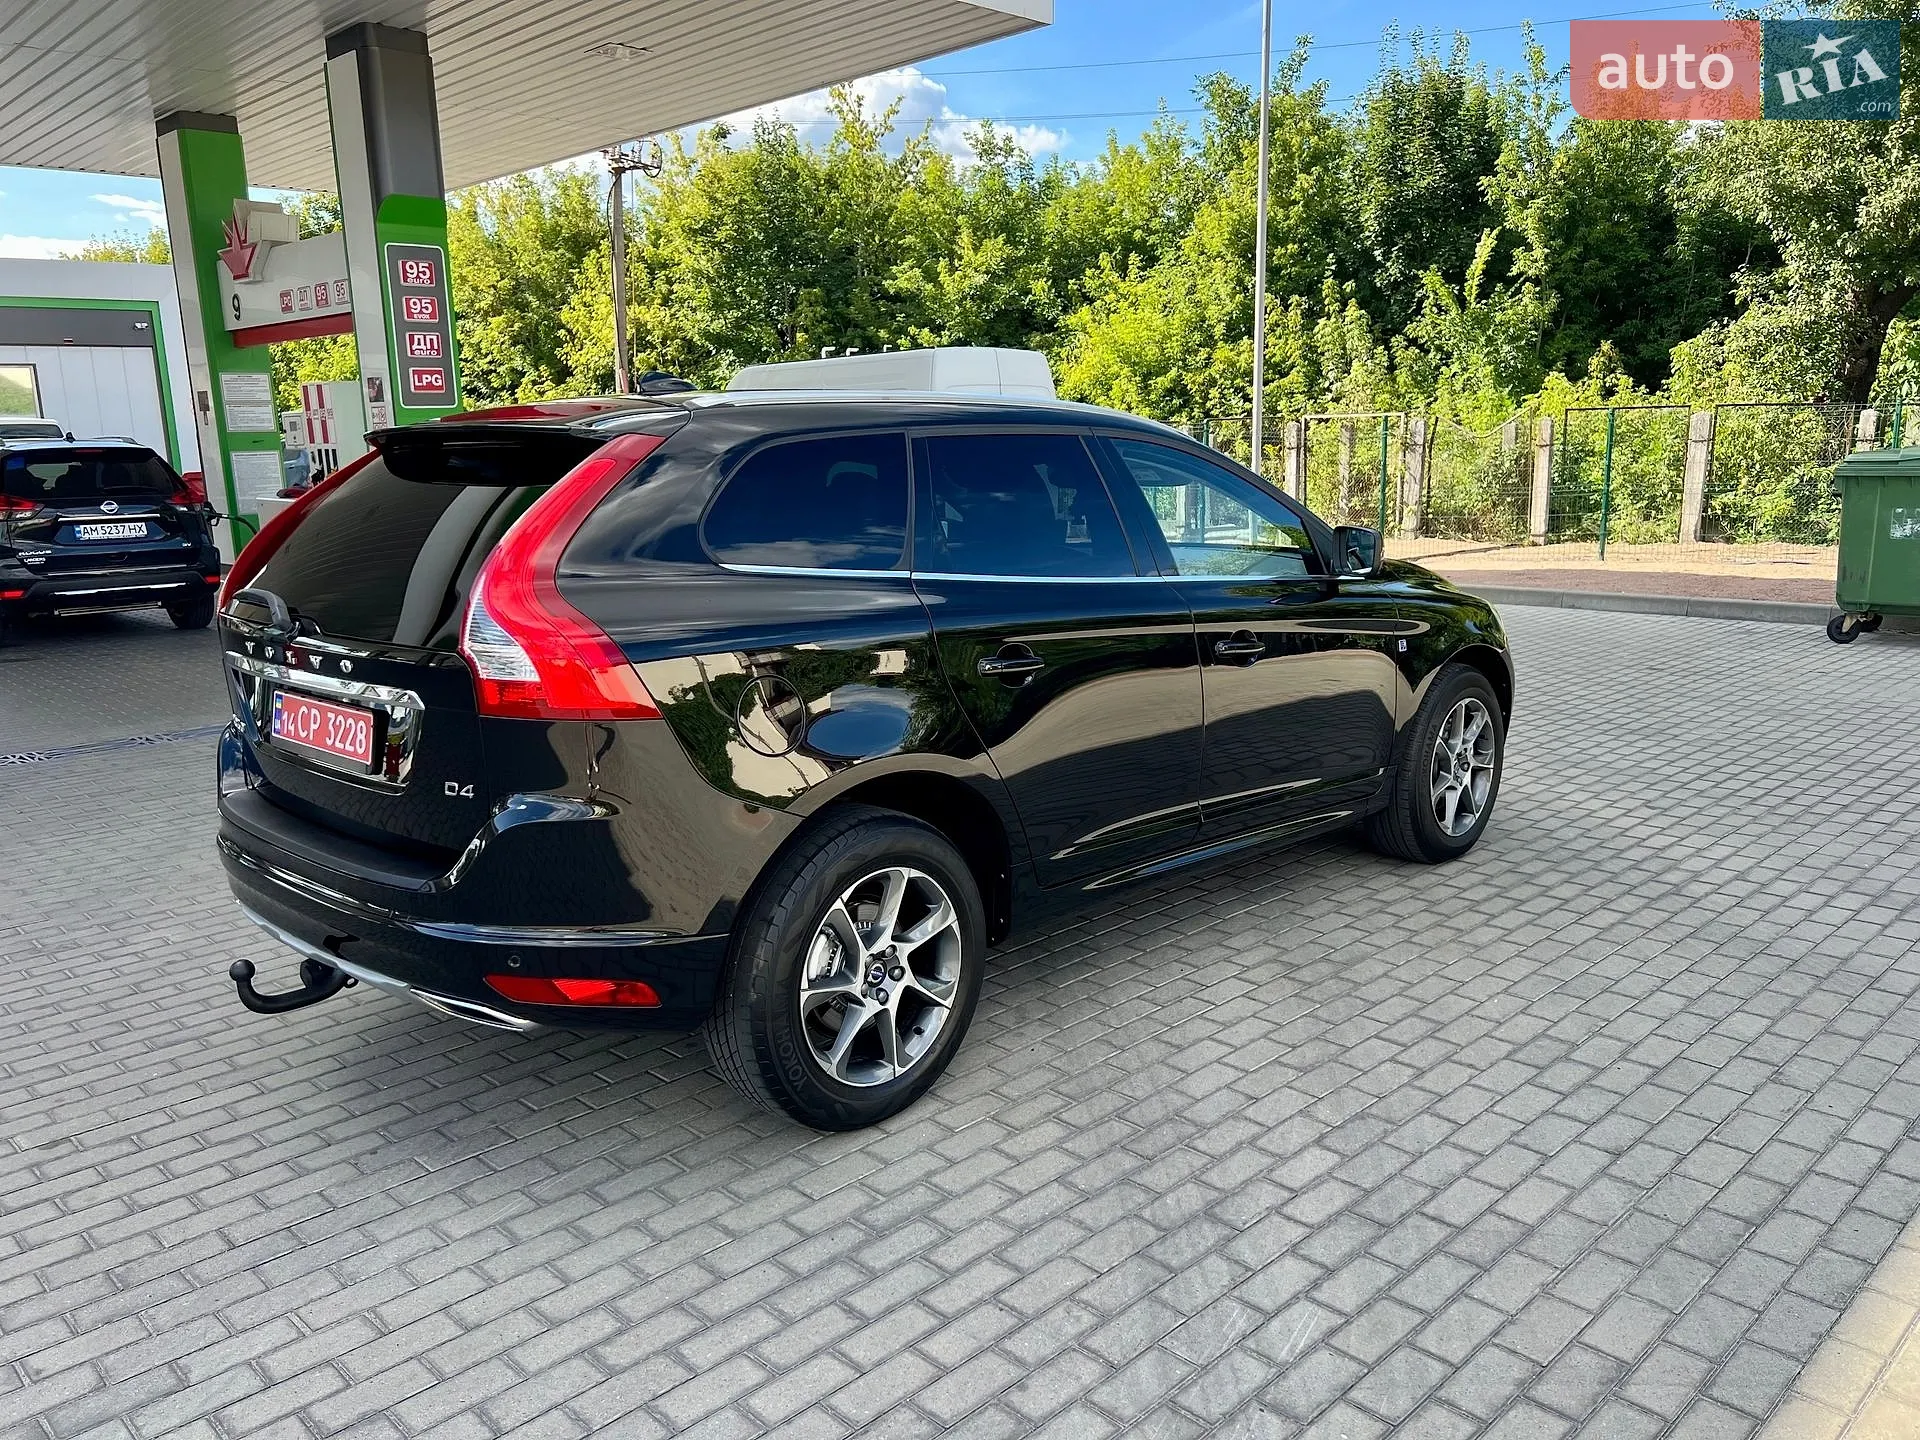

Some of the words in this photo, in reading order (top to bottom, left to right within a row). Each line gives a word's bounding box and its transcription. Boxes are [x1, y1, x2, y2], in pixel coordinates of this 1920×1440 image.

[405, 261, 431, 278] 95
[316, 286, 327, 300] 95
[335, 283, 346, 297] 95
[232, 293, 241, 321] 9
[409, 298, 433, 314] 95
[412, 335, 438, 350] ДП
[414, 374, 443, 386] LPG
[82, 525, 99, 536] AM
[101, 524, 126, 535] 5237
[129, 523, 145, 534] HX
[245, 641, 354, 674] VOLVO
[282, 711, 296, 737] 14
[297, 705, 321, 741] CP
[325, 712, 367, 754] 3228
[444, 781, 475, 799] D4
